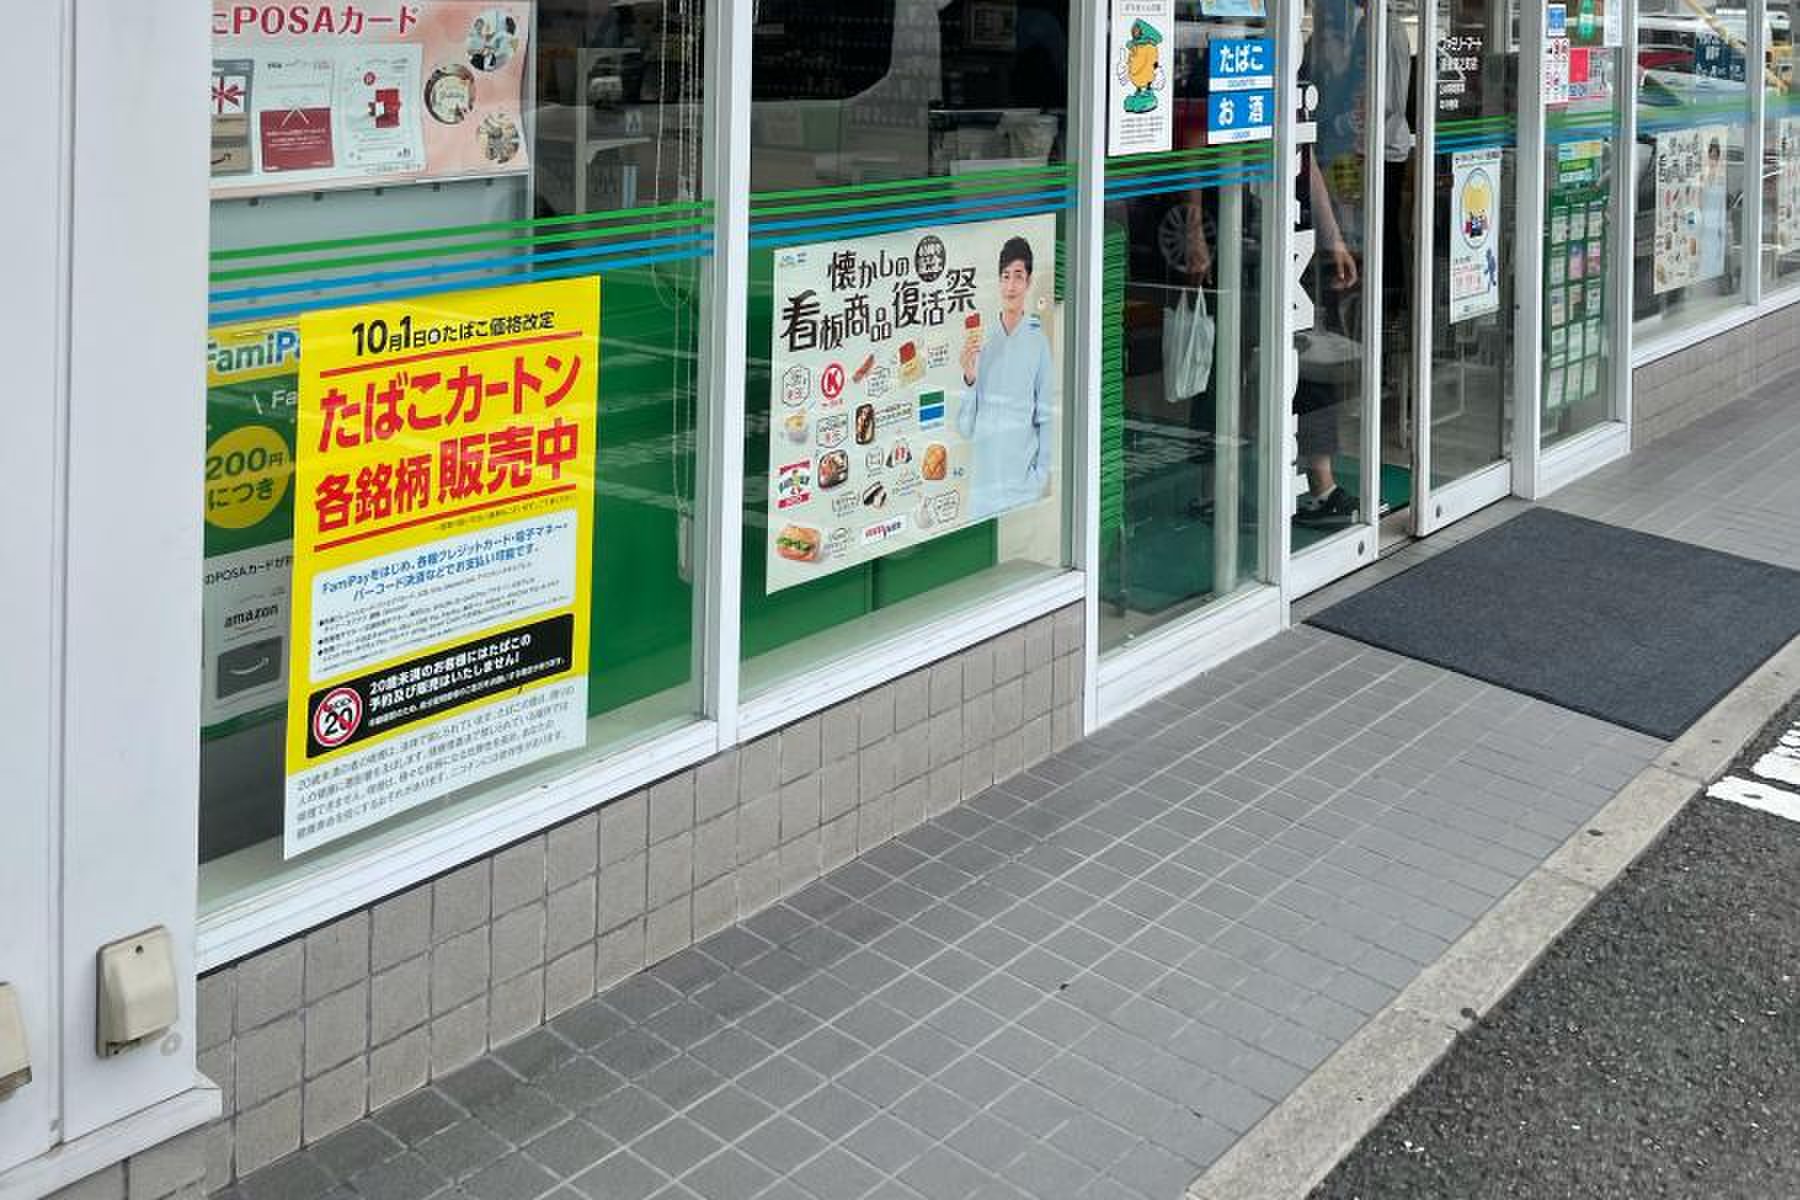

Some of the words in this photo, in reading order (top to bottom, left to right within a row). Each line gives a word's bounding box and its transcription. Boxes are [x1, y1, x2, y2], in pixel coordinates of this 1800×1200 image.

[1219, 43, 1264, 73] たばこ
[827, 249, 910, 292] 懐かしの
[780, 267, 977, 353] 看板商品復活祭
[318, 353, 582, 453] たばこカートン
[314, 452, 432, 535] 各銘柄
[437, 417, 579, 502] 販売中
[224, 604, 279, 628] amazon
